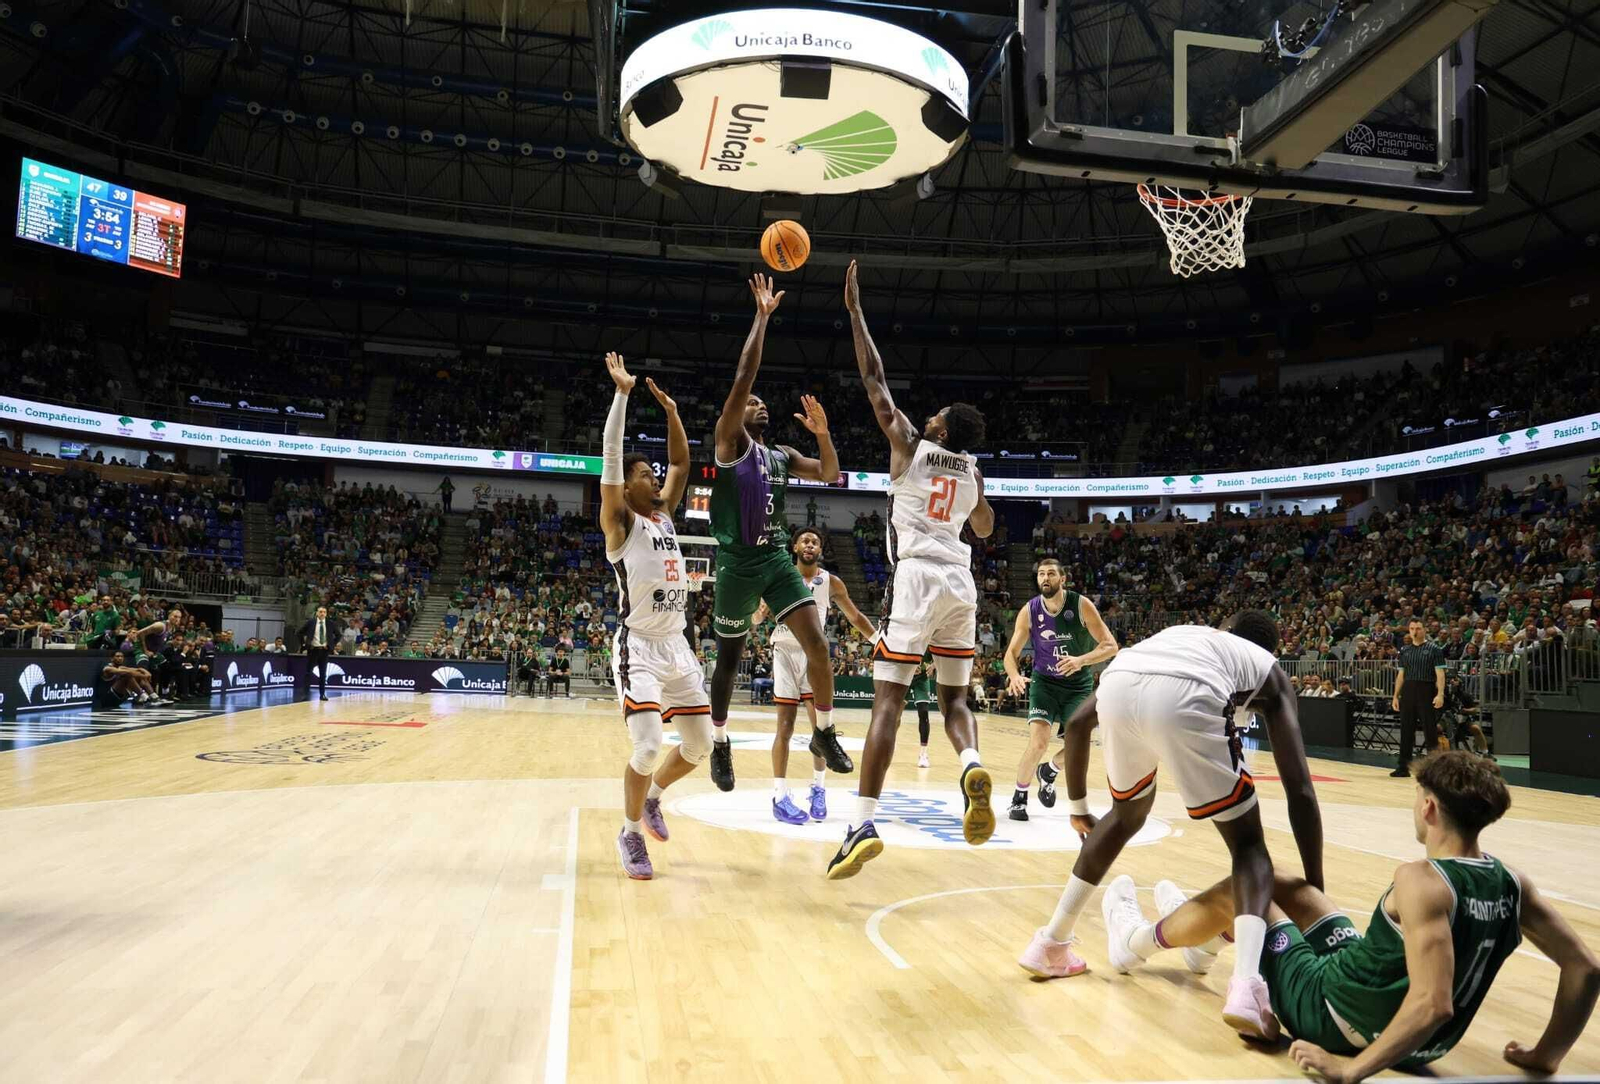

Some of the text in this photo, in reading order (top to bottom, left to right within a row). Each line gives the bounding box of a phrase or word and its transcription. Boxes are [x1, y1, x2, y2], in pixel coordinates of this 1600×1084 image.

[734, 31, 853, 51] Unicaja Banco
[710, 103, 769, 172] Unicaja
[1377, 130, 1428, 142] BASKETBALL
[1377, 138, 1435, 152] CHAMPIONS
[1377, 147, 1408, 157] LEAGUE
[86, 182, 102, 194] 47
[113, 189, 127, 201] 39
[93, 207, 120, 224] 3:54
[25, 406, 102, 427] Compañerismo
[1553, 425, 1585, 439] Pasión
[181, 430, 479, 462] Pasión Dedicación Respeto Equipo Superación Compañerismo
[540, 458, 586, 470] UNICAJA
[926, 453, 970, 475] MAWUGBE
[1217, 478, 1245, 487] Pasión
[1251, 473, 1298, 485] Dedicación
[1303, 470, 1336, 481] Respeto
[1341, 466, 1370, 478] Equipo
[1375, 457, 1421, 473] Superación
[1426, 445, 1485, 465] Compañerismo
[1001, 484, 1029, 493] Equipo
[1034, 483, 1080, 494] Superación
[1086, 483, 1149, 494] Compañerismo
[691, 496, 709, 512] 11
[765, 493, 775, 516] 3
[926, 476, 957, 523] 21
[664, 559, 680, 582] 25
[1052, 644, 1069, 661] 45
[342, 674, 416, 688] Unicaja Banco
[461, 678, 501, 691] Unicaja
[42, 682, 94, 703] Unicaja Banco
